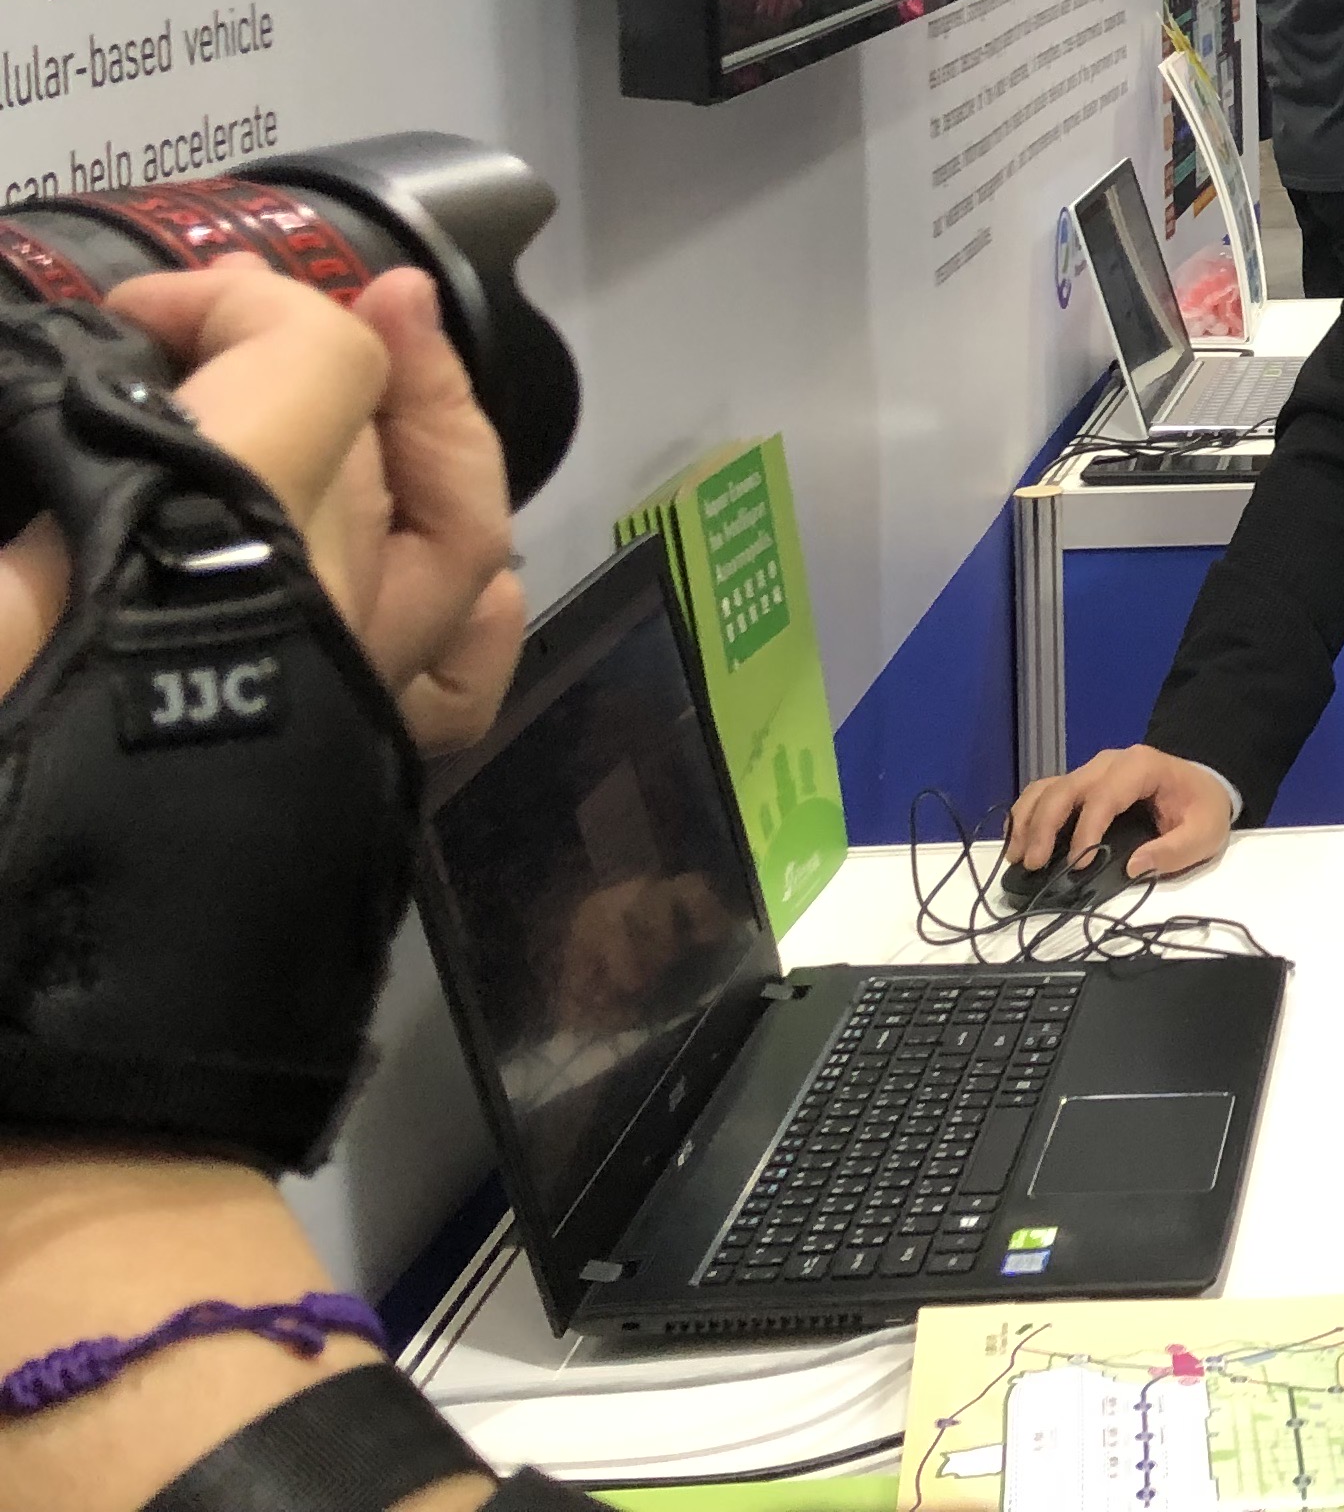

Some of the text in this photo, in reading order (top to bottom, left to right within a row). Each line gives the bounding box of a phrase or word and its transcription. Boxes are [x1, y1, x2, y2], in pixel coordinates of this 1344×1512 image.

[183, 3, 273, 66] vehicle
[143, 104, 278, 182] accelerate
[151, 664, 271, 728] JJC
